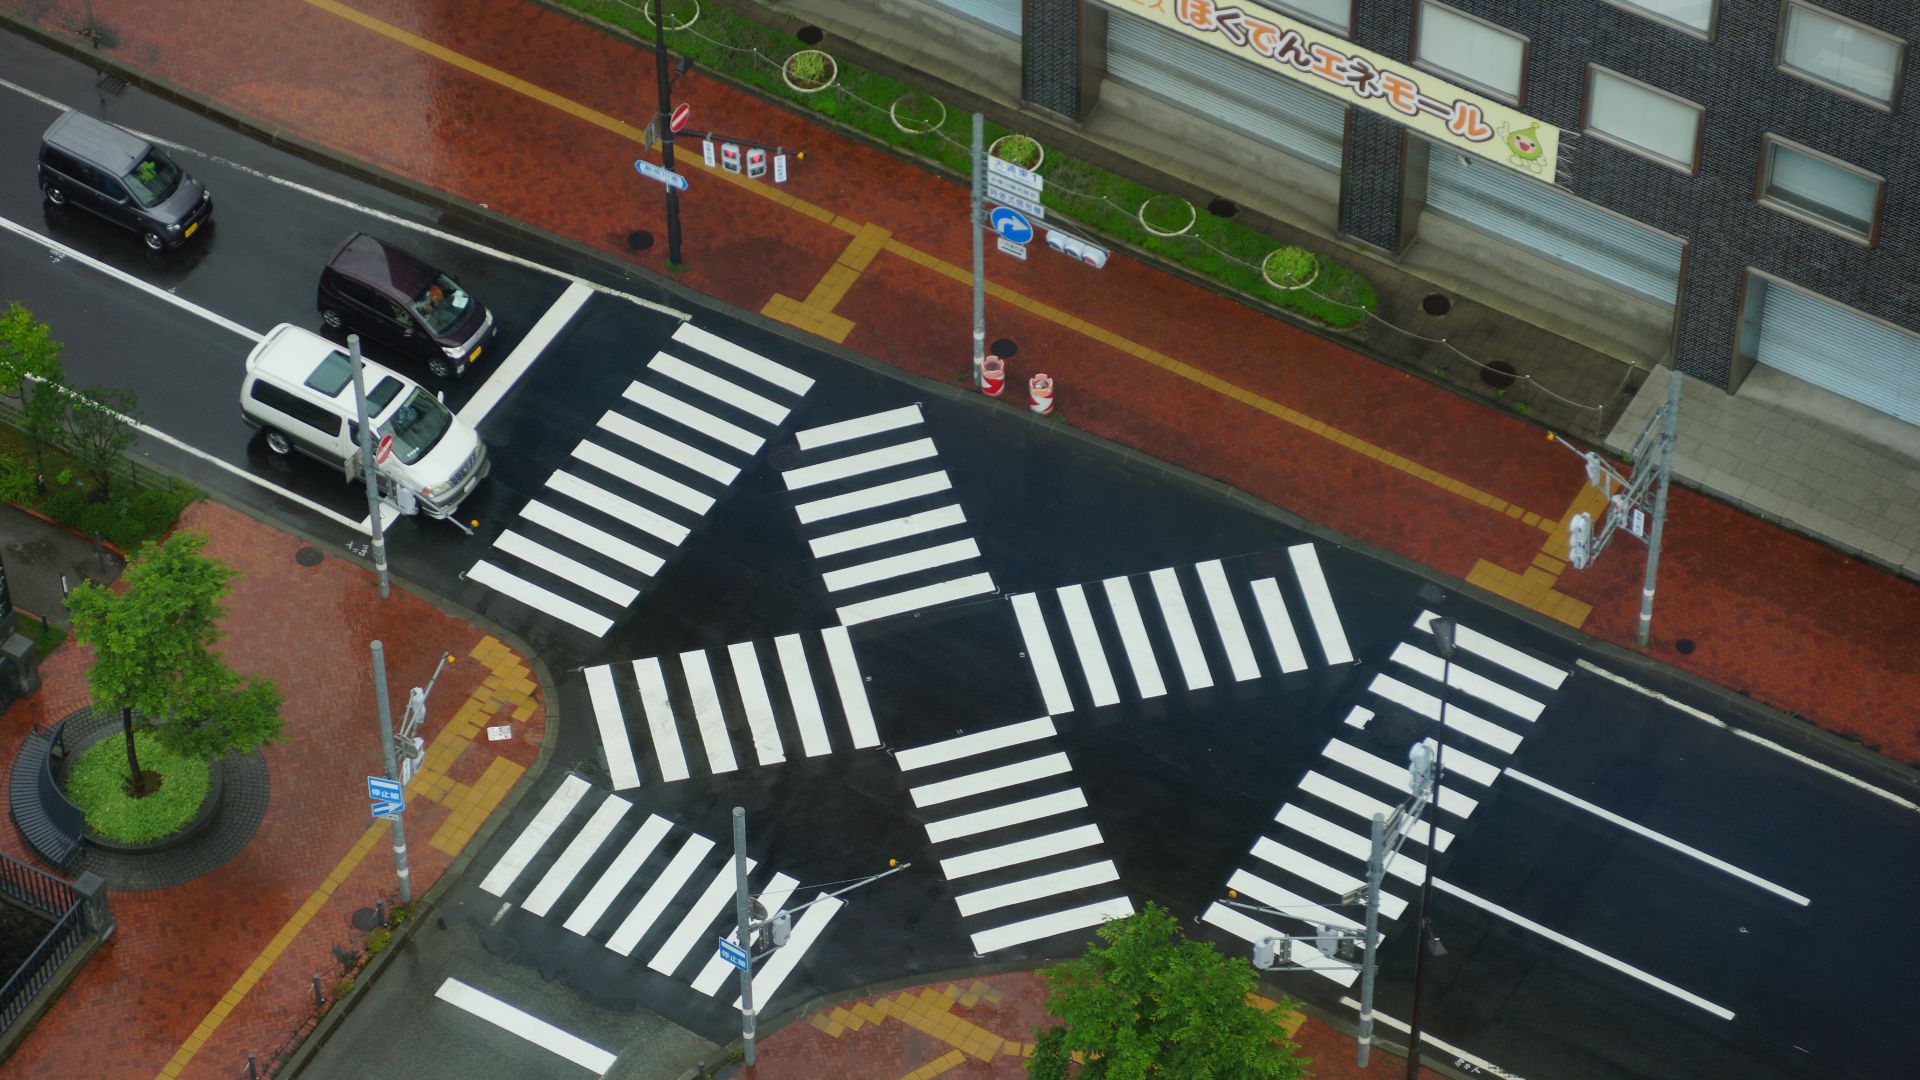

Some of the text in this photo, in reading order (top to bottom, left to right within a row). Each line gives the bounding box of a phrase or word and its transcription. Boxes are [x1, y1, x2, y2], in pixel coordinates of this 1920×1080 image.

[1176, 0, 1494, 142] ほくでんエネモール
[372, 789, 399, 800] 停止線
